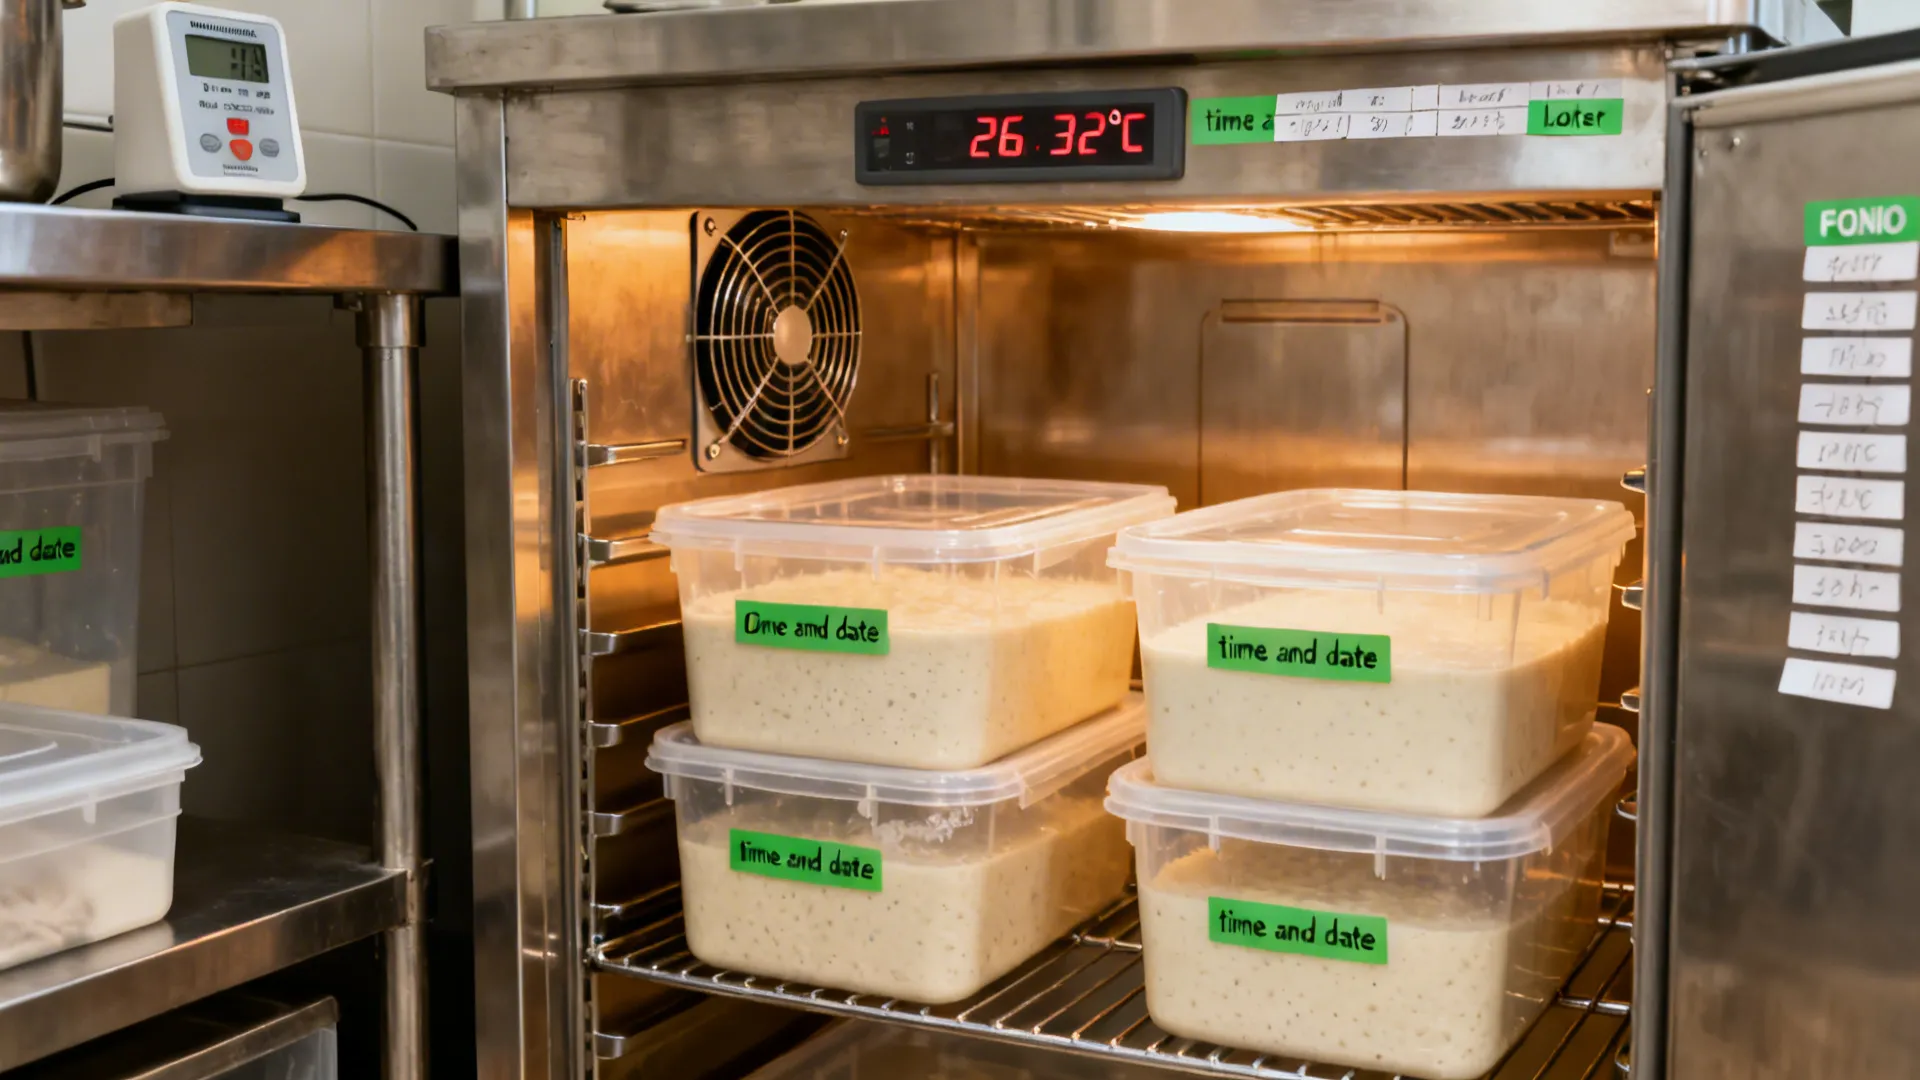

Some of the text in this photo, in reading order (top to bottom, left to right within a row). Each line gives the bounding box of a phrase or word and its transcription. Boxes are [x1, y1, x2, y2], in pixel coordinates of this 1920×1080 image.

[1205, 108, 1255, 132] time
[1819, 204, 1908, 238] FONIO
[29, 534, 76, 562] date
[836, 615, 880, 643] date
[1218, 635, 1378, 669] time and date
[786, 846, 822, 873] and
[829, 848, 874, 880] date
[1218, 909, 1376, 951] time and date
